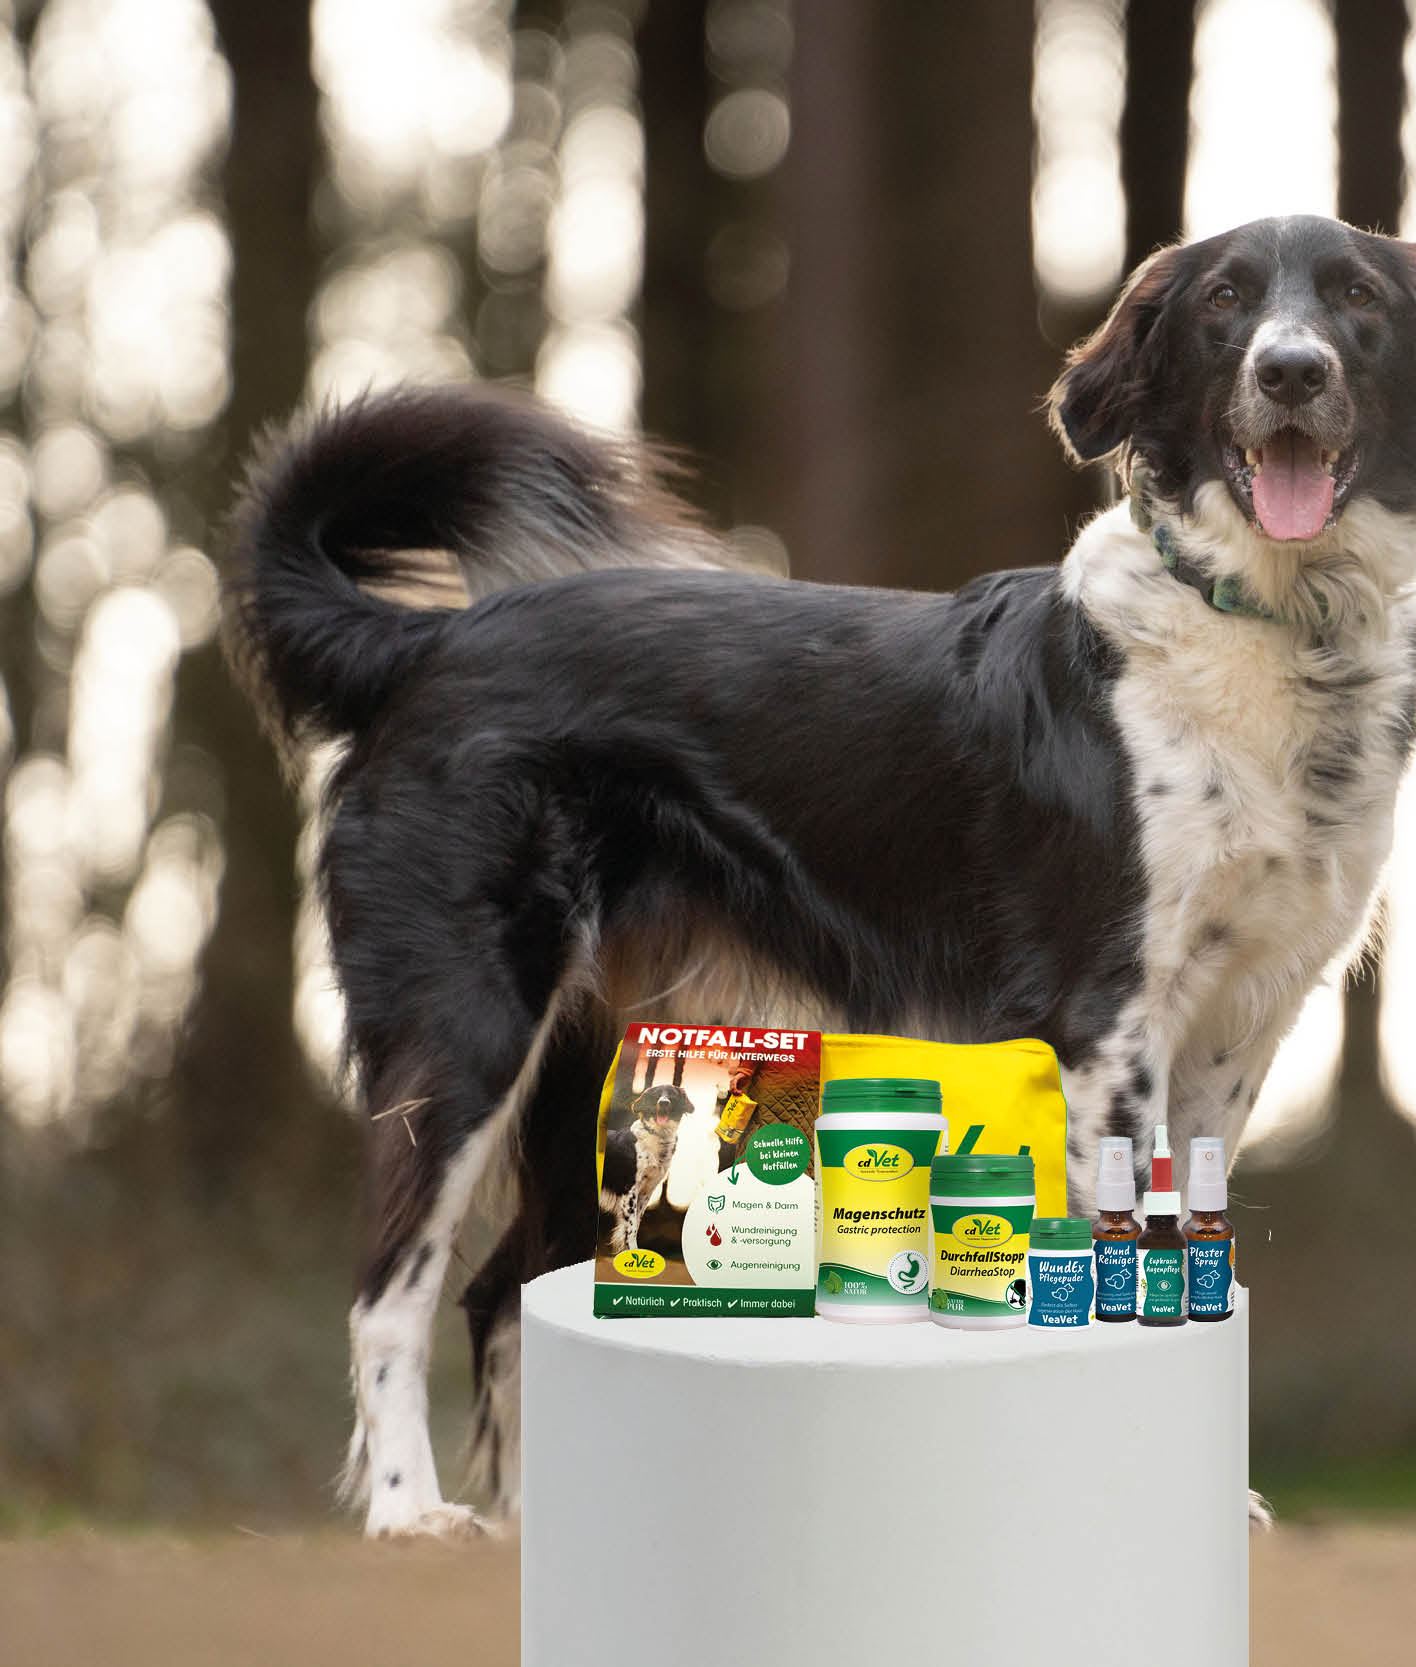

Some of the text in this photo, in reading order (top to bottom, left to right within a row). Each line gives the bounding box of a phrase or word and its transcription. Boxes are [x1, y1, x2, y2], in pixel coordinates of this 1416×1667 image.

[638, 1027, 808, 1050] NOTFALL-SET
[646, 1049, 796, 1063] ERSTE HILFE FÜR UNTERWEGS
[753, 1137, 804, 1148] Schnelle Hilfe
[760, 1150, 799, 1160] bei kleinen
[762, 1161, 798, 1171] Notfällen
[732, 1200, 799, 1211] Magen & Darm
[833, 1207, 926, 1223] Magenschutz
[731, 1226, 798, 1238] Wundreinigung
[837, 1224, 921, 1236] Gastric protection
[731, 1237, 792, 1248] & -versorgung
[1104, 1245, 1130, 1256] Wund
[1189, 1247, 1224, 1258] Plaster
[940, 1250, 1025, 1264] DurchfallStopp
[1098, 1254, 1135, 1267] Reiniger
[1194, 1257, 1219, 1267] Spray
[730, 1260, 801, 1272] Augenreinigung
[950, 1265, 1015, 1278] DiarrheaStop
[1039, 1260, 1084, 1273] WundEx
[1039, 1273, 1084, 1284] Pflegepuder
[625, 1296, 796, 1308] Natürlich Praktisch Immer dabei
[1101, 1303, 1132, 1311] VeaVet
[1190, 1303, 1223, 1311] VeaVet
[1042, 1314, 1078, 1324] VeaVet
